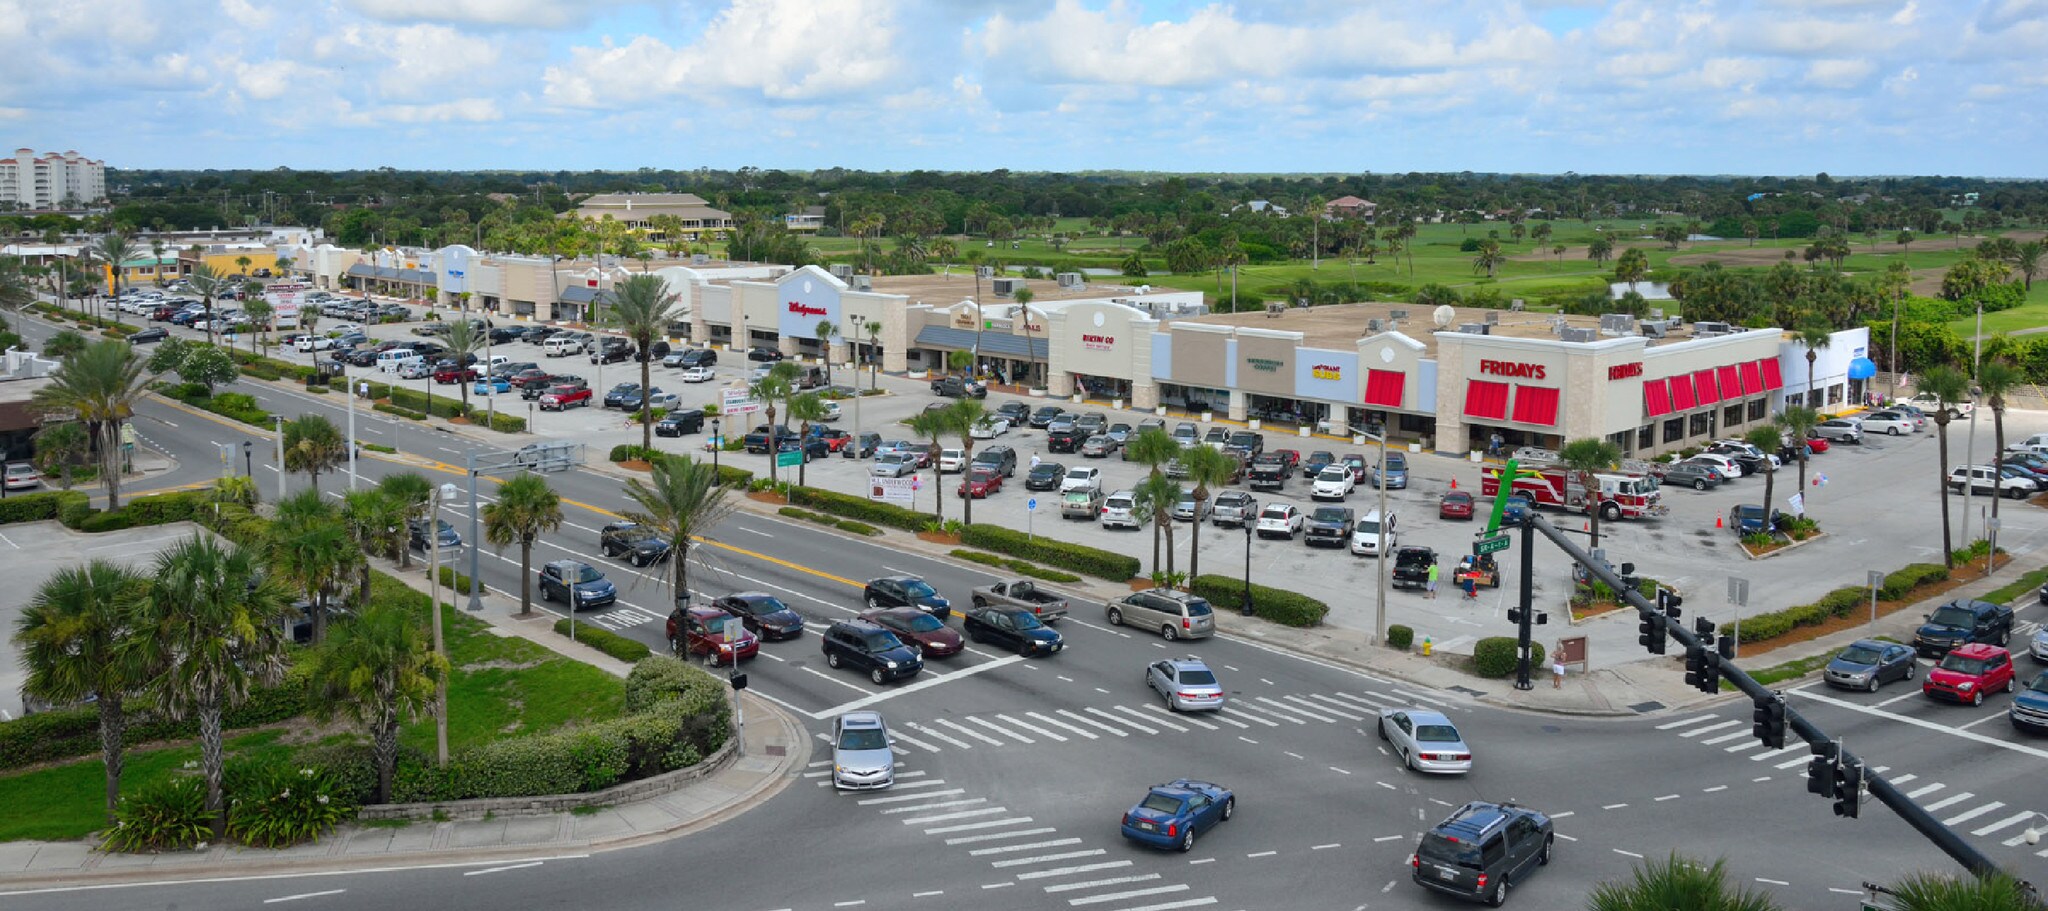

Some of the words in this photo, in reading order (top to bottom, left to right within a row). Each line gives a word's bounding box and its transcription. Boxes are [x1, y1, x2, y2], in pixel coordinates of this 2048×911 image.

[788, 301, 827, 317] Walgreens
[1312, 369, 1341, 381] SUBS
[1480, 359, 1546, 381] FRIDAYS
[1608, 362, 1643, 381] FRIDAYS
